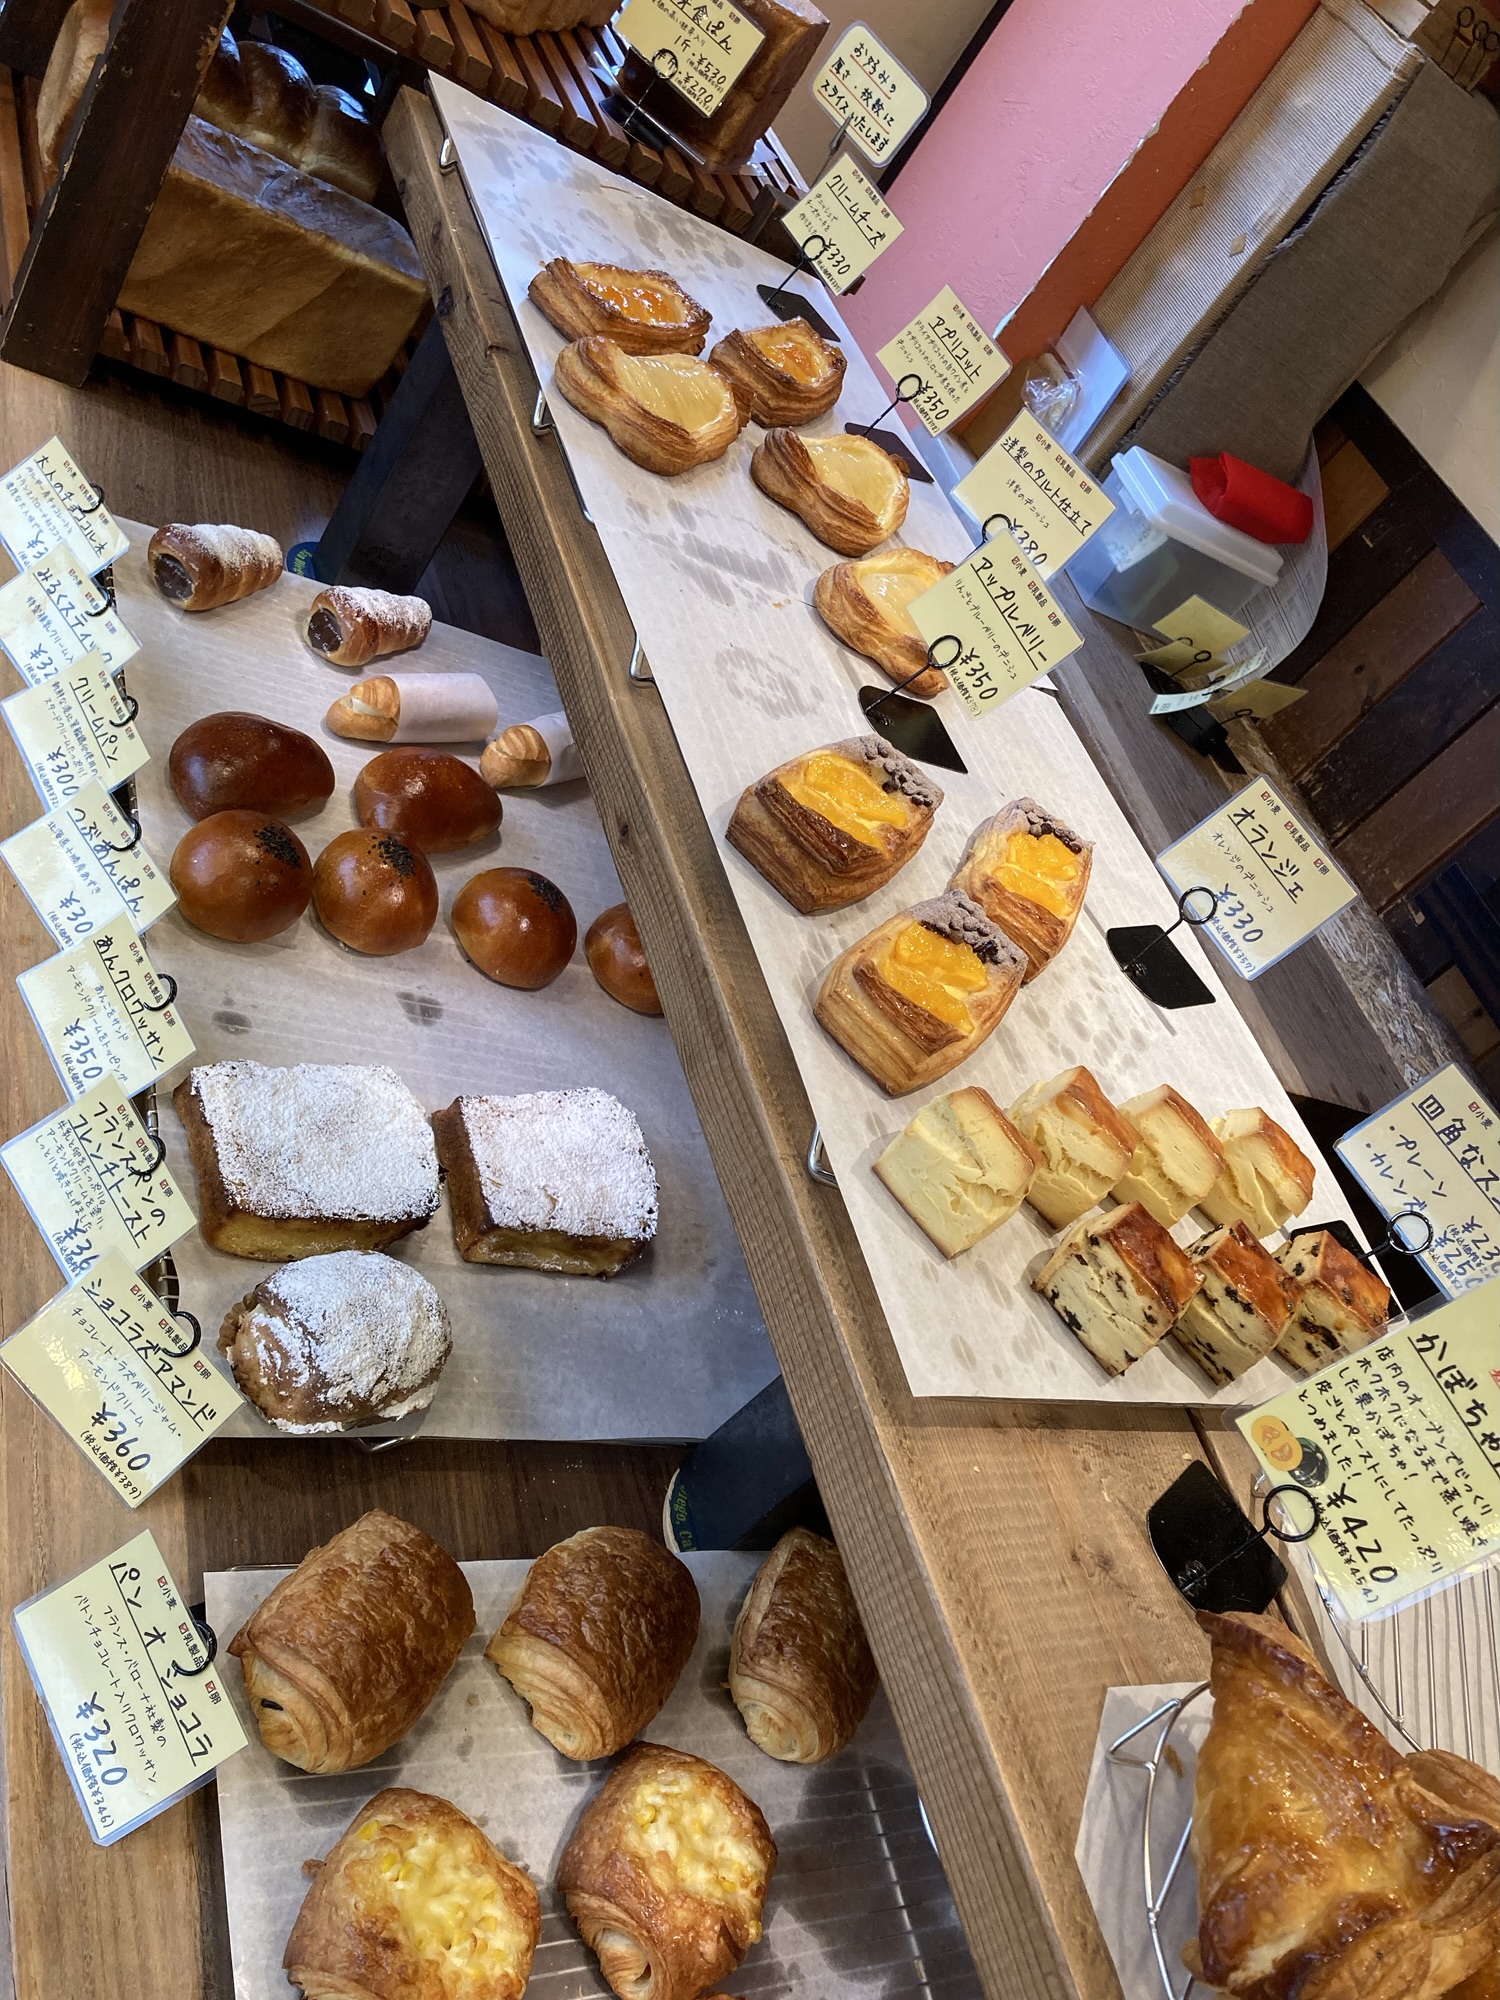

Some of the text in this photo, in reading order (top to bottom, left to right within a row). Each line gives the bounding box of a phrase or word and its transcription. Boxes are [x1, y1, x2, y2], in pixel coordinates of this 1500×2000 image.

[853, 42, 896, 93] お好みの
[820, 79, 890, 152] スライスいたします
[830, 174, 886, 246] クリームチーズ
[820, 237, 851, 275] ¥330
[931, 315, 982, 378] アプリコット
[956, 309, 965, 320] 小麦
[968, 326, 982, 342] 乳製品
[915, 380, 950, 420] ¥350
[34, 455, 107, 555] 大人のチョココルネ
[67, 466, 77, 478] 小麦
[82, 488, 98, 508] 乳製品
[1000, 436, 1093, 534] 洋梨のタルト仕立て
[1005, 478, 1050, 528] 洋梨のデニッシュ
[1040, 439, 1092, 494] 小麦 乳製品 卵
[73, 574, 83, 586] 小麦
[88, 596, 100, 611] 乳製
[971, 556, 1047, 662] アップルベリー
[1013, 562, 1061, 627] 小麦 乳製品 卵
[101, 677, 111, 690] 小麦
[112, 701, 126, 721] 乳製品
[956, 647, 998, 700] ¥350
[70, 676, 118, 761] クリームパン
[34, 762, 59, 807] (税込価格¥32
[46, 745, 80, 796] ¥300
[47, 821, 101, 895] 北海道十勝産あずき
[74, 807, 144, 913] つぶあんぱん
[105, 810, 118, 824] 小麦
[146, 870, 155, 880] 卵
[1212, 832, 1274, 913] オレンジのデニッシュ
[1229, 807, 1304, 898] オランジェ
[1266, 799, 1330, 875] 小麦 乳製品 卵
[1208, 914, 1255, 973] 税込価格¥357)
[1211, 883, 1264, 943] ¥330
[66, 964, 128, 1082] アーモンドクリームをトッピング
[92, 934, 164, 1063] あんクロワッサン
[94, 984, 129, 1041] あんこをサンド
[132, 949, 175, 1027] 小麦 乳製品 卵
[62, 1017, 103, 1079] ¥350
[121, 1113, 135, 1131] 小麦
[162, 1186, 174, 1198] 卵
[1417, 1093, 1500, 1208] 四角なス
[1475, 1110, 1494, 1130] 小麦
[35, 1134, 93, 1231] しっとりと焼き上げました
[46, 1127, 104, 1230] アーモンドクリームを塗り、
[57, 1120, 106, 1205] 牛乳と卵をたっぷり。
[68, 1113, 151, 1244] フレンチトースト
[93, 1101, 166, 1226] フランスパンの
[52, 1231, 81, 1277] (税込価格
[83, 1278, 217, 1426] ショコラズアマンド
[137, 1293, 211, 1380] 小麦 乳製品 卵
[78, 1348, 144, 1427] アーモンドクリーム
[1410, 1333, 1500, 1471] かぼちゃ
[80, 1430, 142, 1500] (税込価格¥389)
[90, 1401, 151, 1471] ¥360
[1356, 1357, 1489, 1546] ホクホクになるまで蒸し焼き
[1375, 1345, 1493, 1516] 店内のオーブンでじっくり
[1314, 1379, 1443, 1573] 皮ごとペーストにしてたっぷり
[1326, 1482, 1398, 1583] ¥420
[103, 1604, 167, 1748] フランス・バローナ社製の
[162, 1587, 222, 1705] 小麦 乳製品 卵
[73, 1595, 157, 1783] バトンチョコレート入りクロワッサン
[75, 1690, 128, 1785] ¥320
[69, 1732, 115, 1828] (税込価格¥346)
